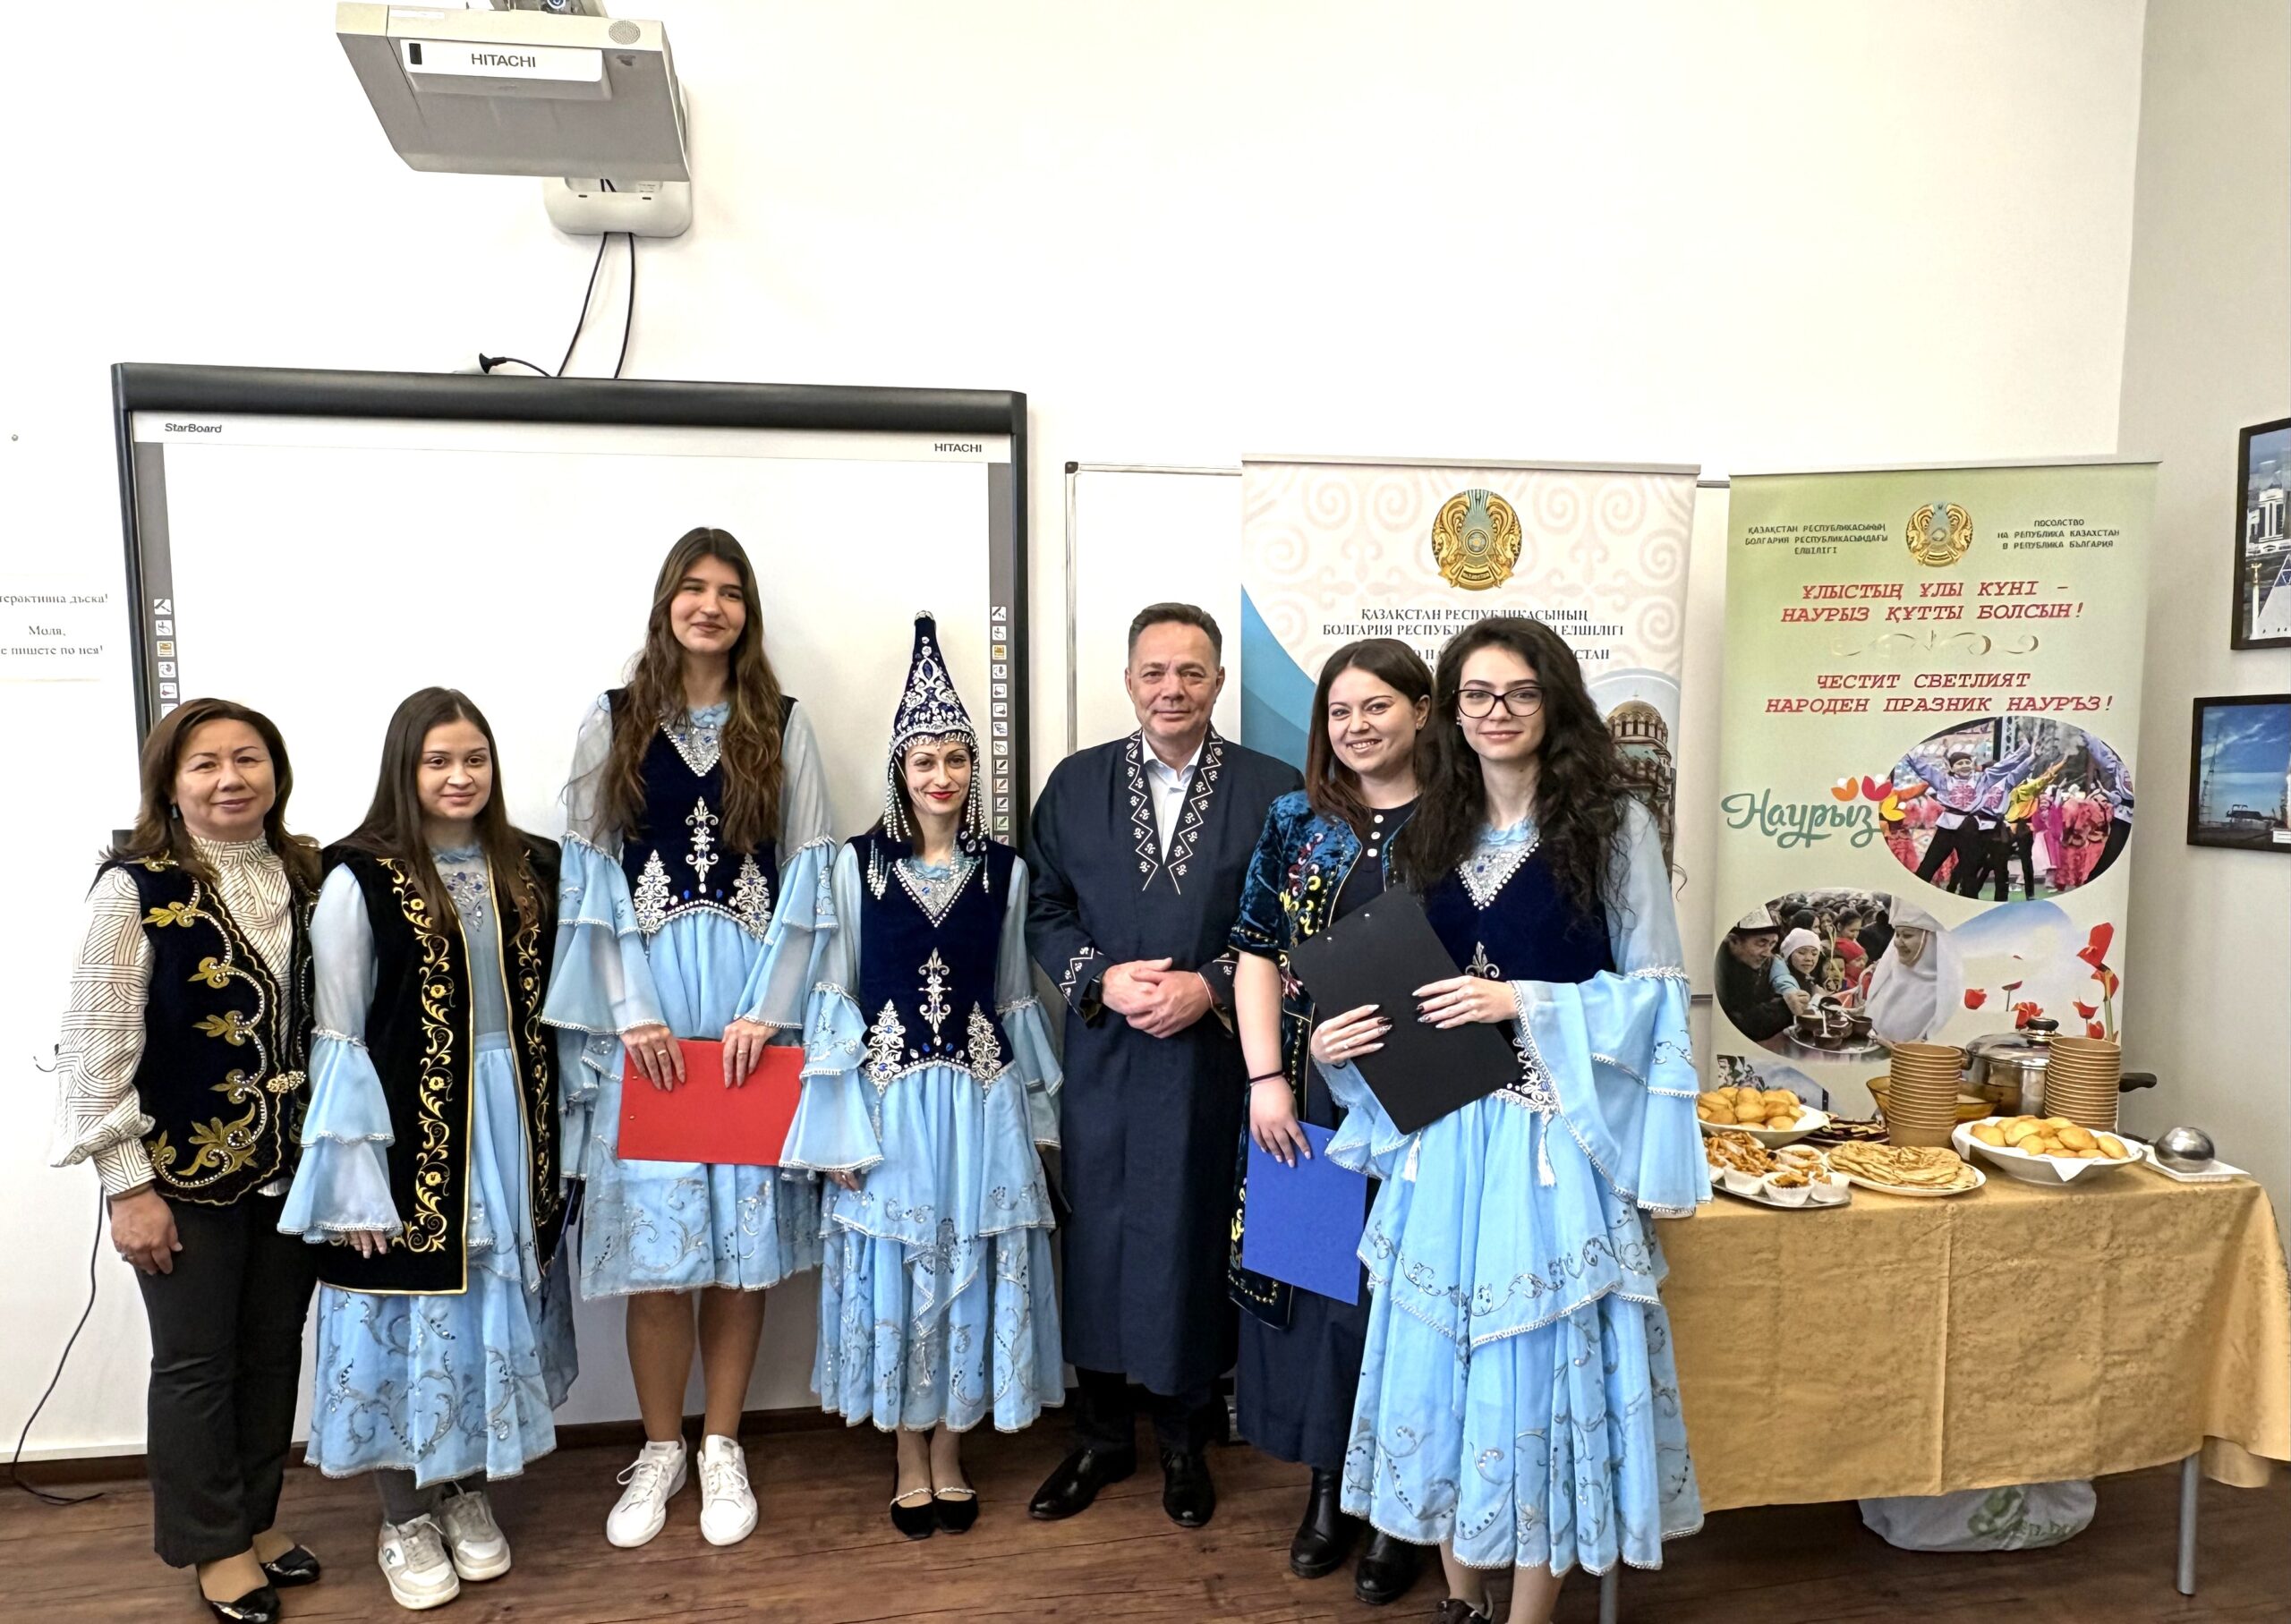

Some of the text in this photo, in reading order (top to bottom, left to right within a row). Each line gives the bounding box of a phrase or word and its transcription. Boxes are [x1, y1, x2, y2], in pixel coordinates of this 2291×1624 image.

[471, 53, 536, 68] HITACHI
[164, 422, 223, 434] StarBoard
[934, 443, 983, 453] HITACHI
[2033, 518, 2085, 528] ПОСОЛСТВО
[2014, 530, 2065, 539] РЕПУБЛИКА
[2069, 529, 2120, 538] КАЗАХСТАН
[2013, 540, 2065, 550] РЕПУБЛИКА
[1780, 606, 1870, 623] НАУРЫЗ
[1976, 601, 2084, 620] БОЛСЫН!
[28, 625, 66, 636] Моля,
[1323, 624, 1392, 636] БОЛГАРИЯ
[11, 647, 57, 655] пишете
[60, 647, 76, 655] по
[1817, 673, 2031, 690] ЧЕСТИТ СВЕТЛИЯТ
[1765, 695, 2113, 715] НАРОДЕН ПРАЗНИК НАУРЪЗ!
[1721, 788, 1882, 849] Наурыз
